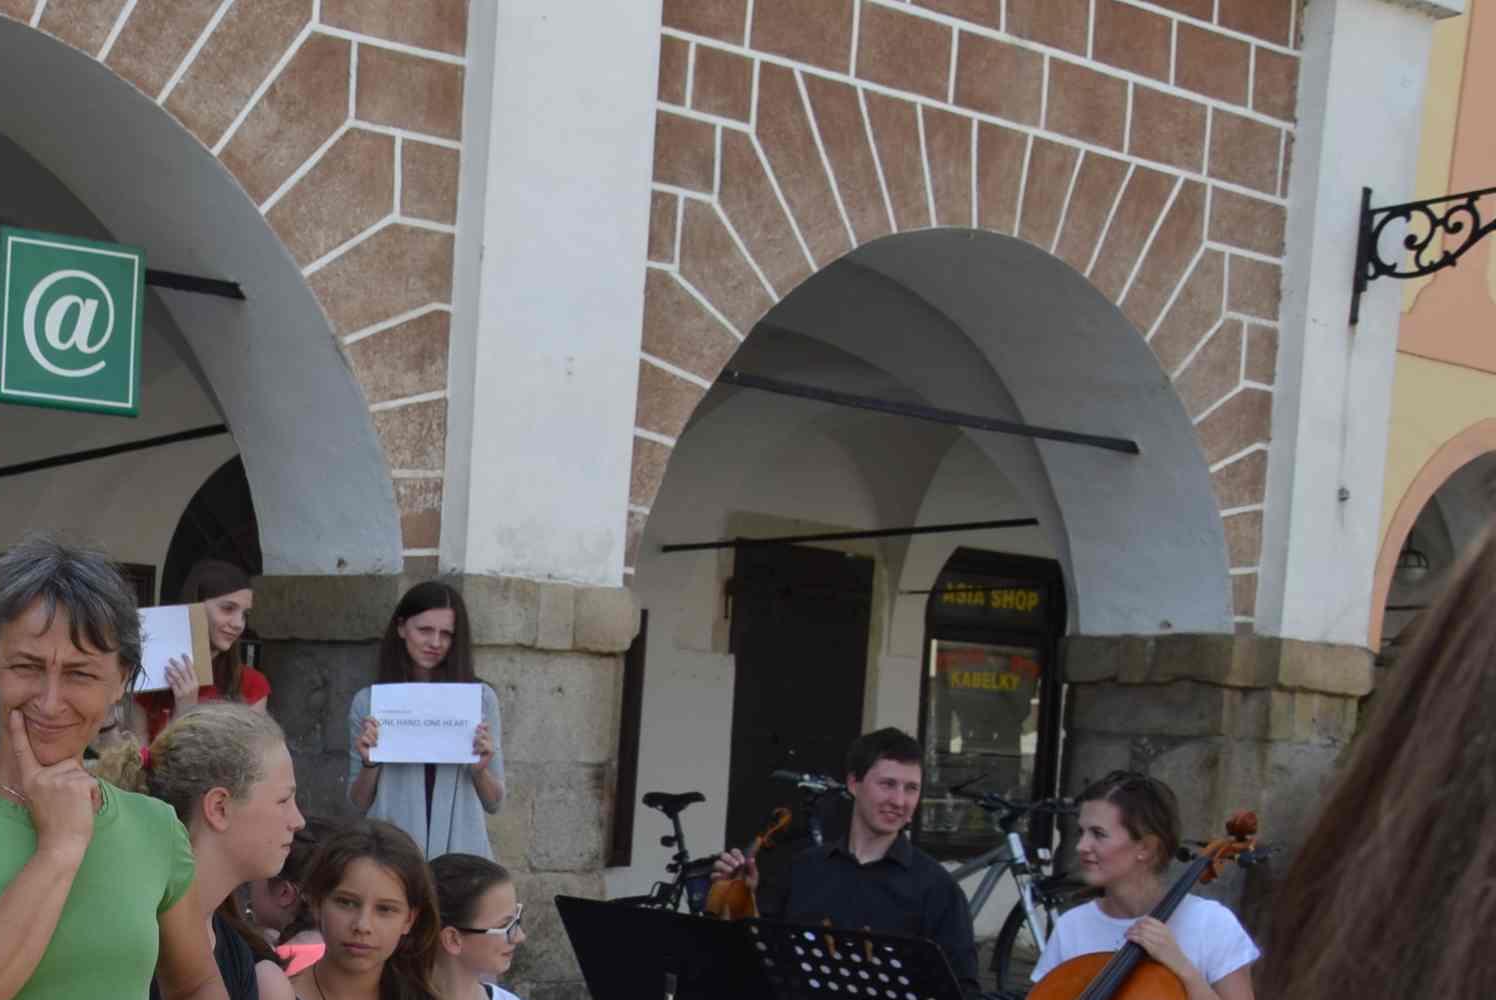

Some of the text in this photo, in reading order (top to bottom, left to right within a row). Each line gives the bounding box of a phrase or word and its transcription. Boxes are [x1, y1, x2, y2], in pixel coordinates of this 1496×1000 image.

[24, 270, 115, 377] @
[943, 583, 1040, 612] ASIA SHOP
[951, 672, 1021, 691] KABELKY
